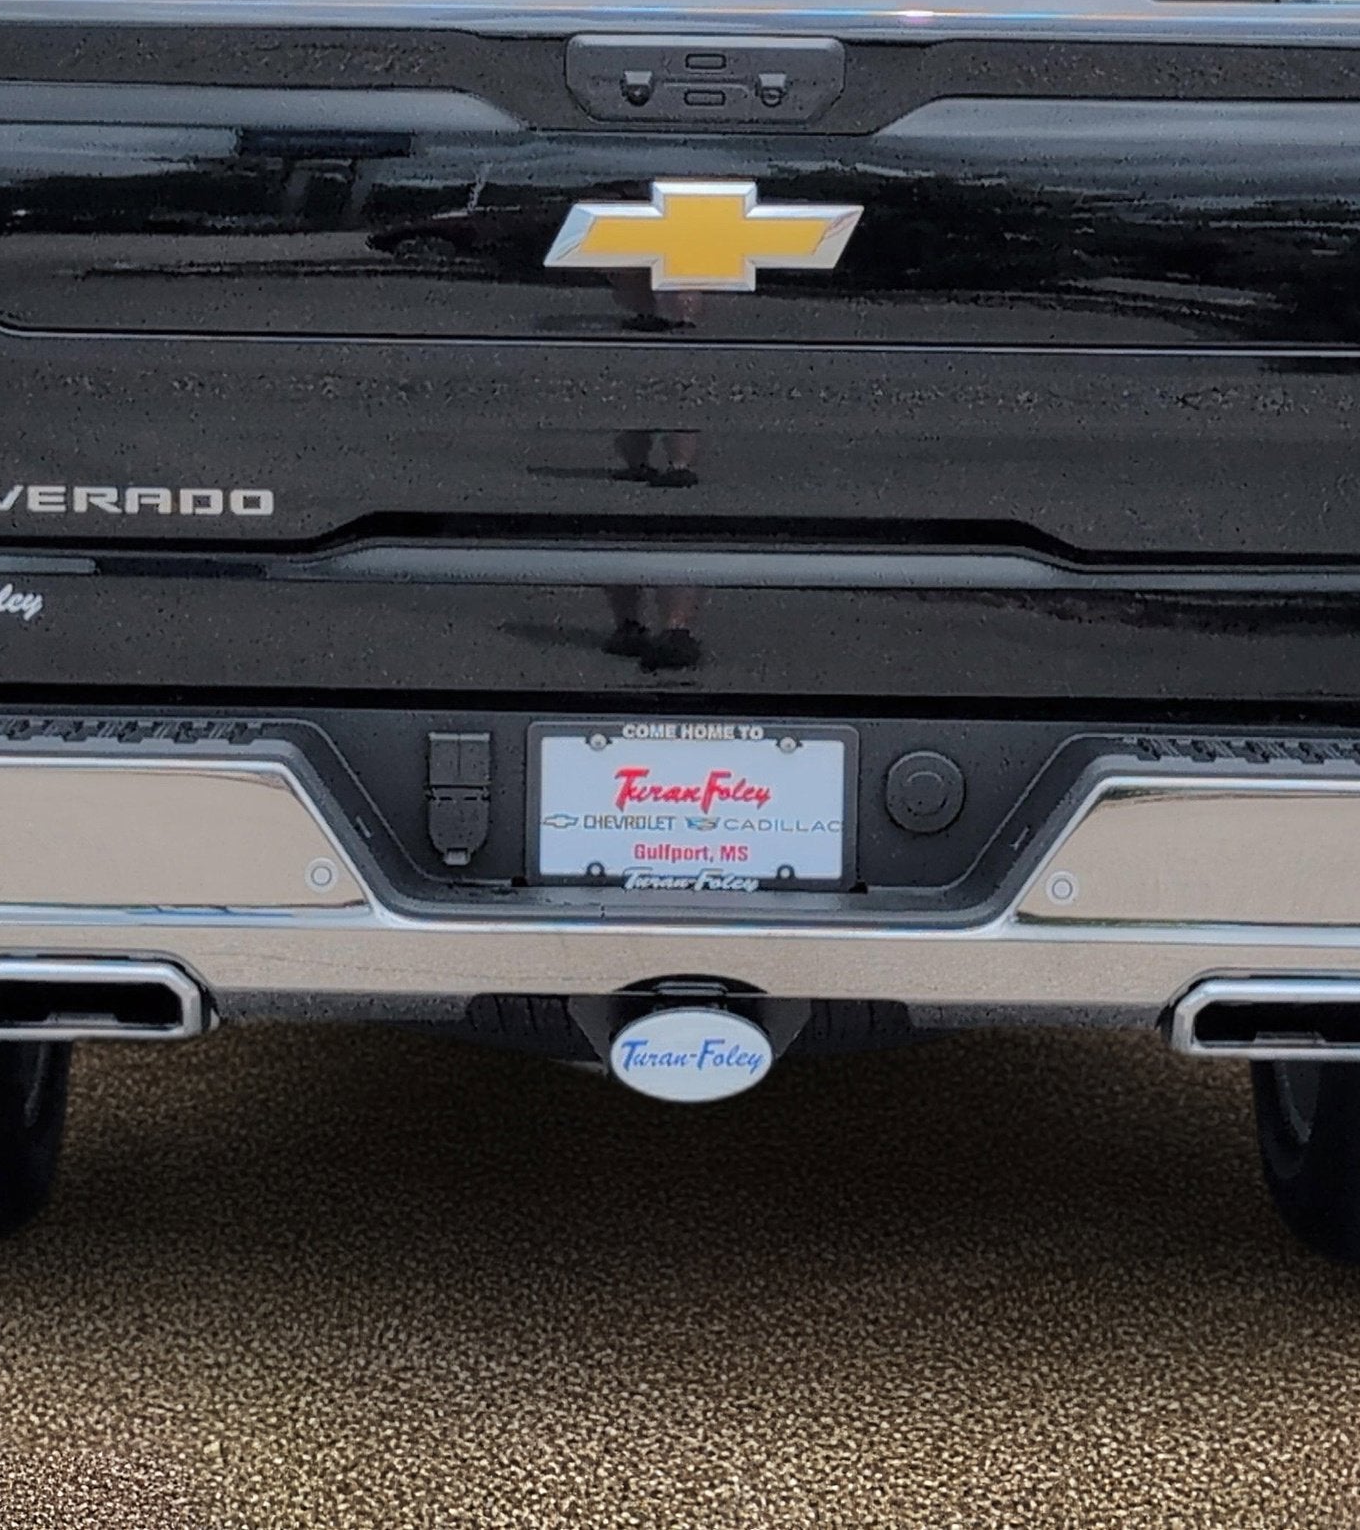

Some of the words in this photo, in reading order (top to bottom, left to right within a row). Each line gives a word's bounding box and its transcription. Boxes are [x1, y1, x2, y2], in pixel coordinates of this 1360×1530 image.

[622, 723, 677, 740] COME
[680, 724, 736, 740] HOME
[738, 724, 765, 741] TO
[583, 814, 677, 831] CHEVROLET
[723, 818, 842, 833] CADILLAC
[634, 843, 715, 863] Gulfport,
[719, 845, 749, 861] MS
[620, 1038, 764, 1075] Turan-Foley
